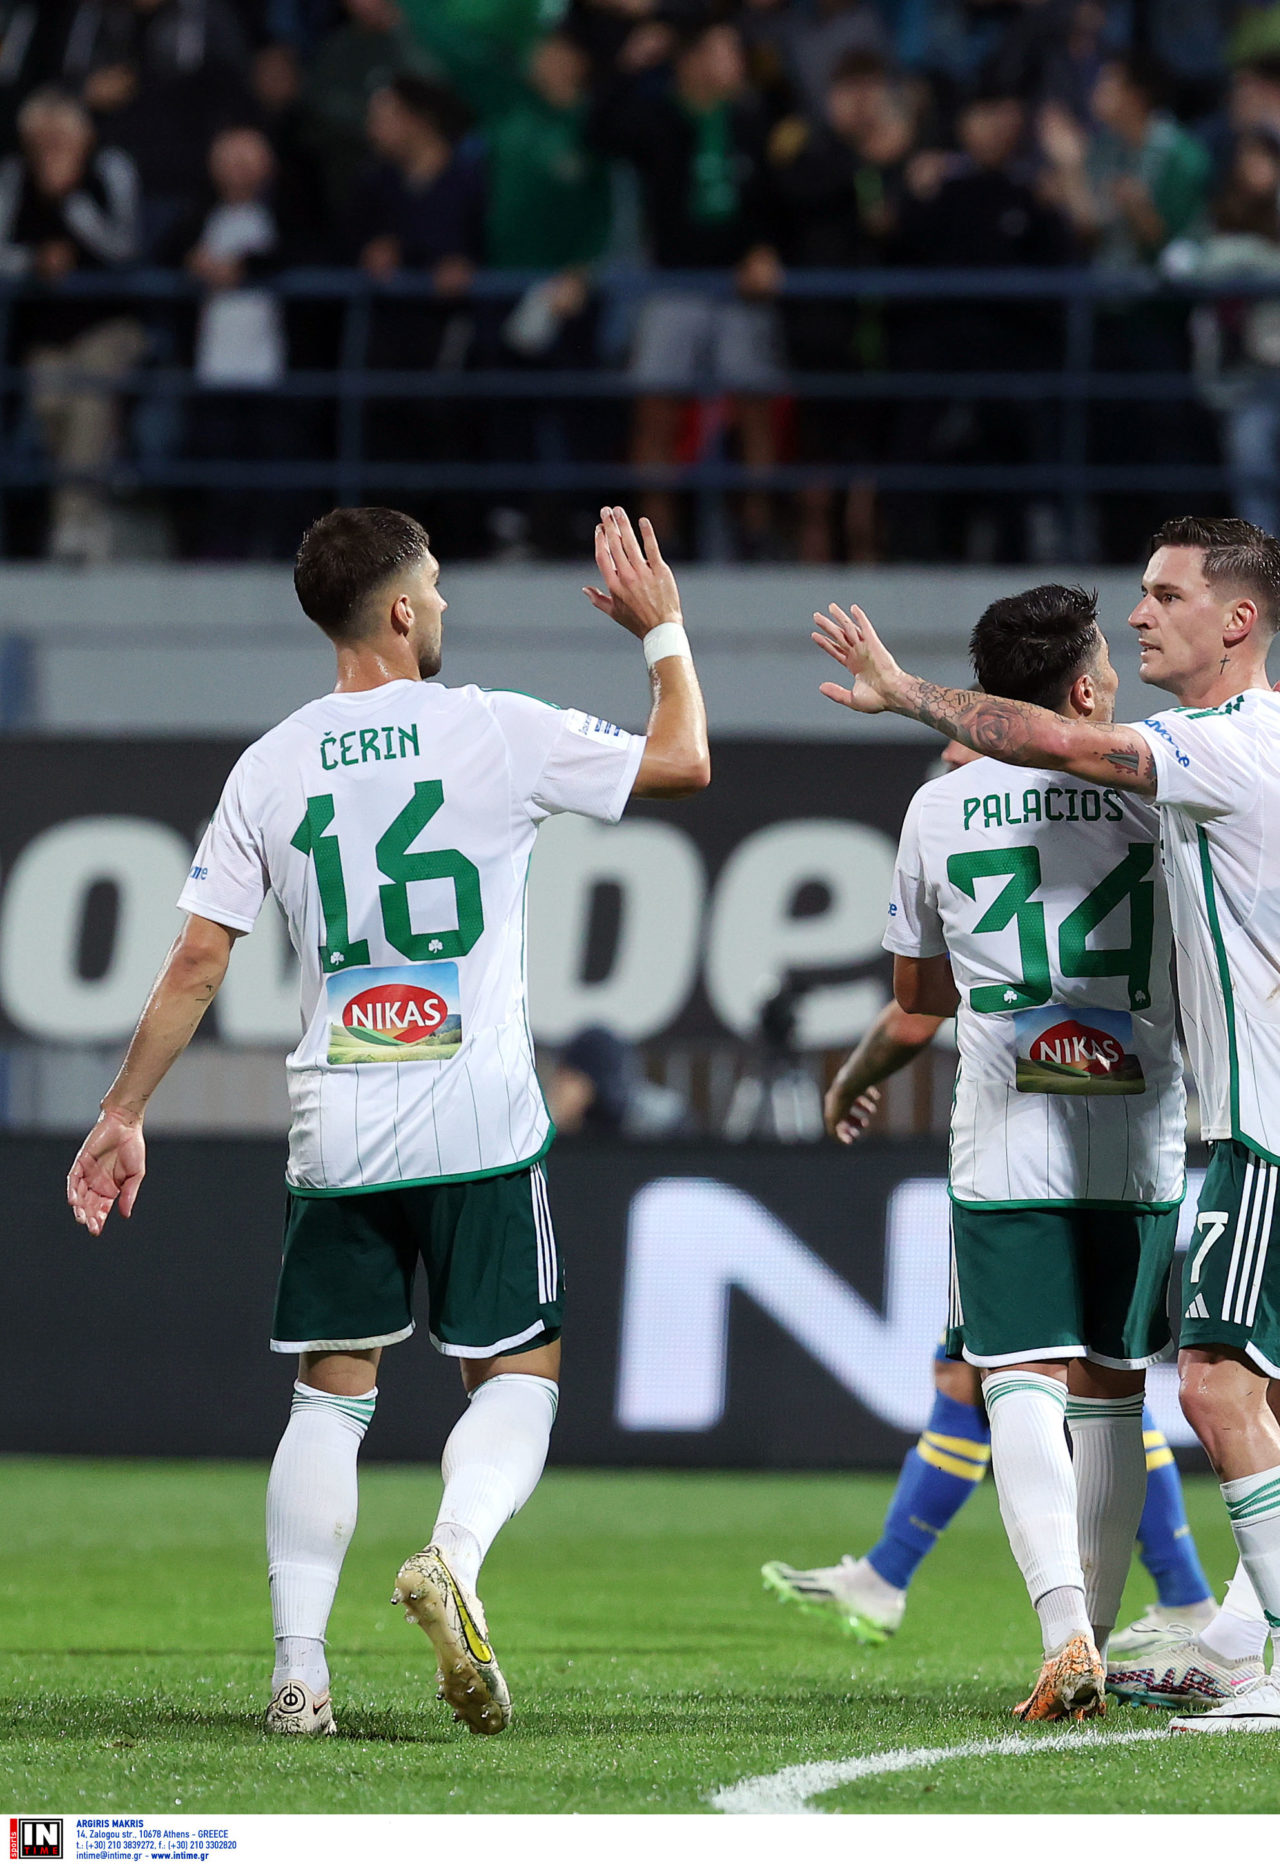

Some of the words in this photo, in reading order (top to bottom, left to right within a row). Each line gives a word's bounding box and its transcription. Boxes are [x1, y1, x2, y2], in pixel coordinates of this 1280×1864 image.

[320, 723, 420, 771] ČERIN
[963, 787, 1124, 831] PALACIOS
[290, 779, 484, 974] 16
[946, 843, 1155, 1014] 34
[350, 997, 442, 1030] NIKAS
[1039, 1035, 1120, 1064] NIKAS
[1190, 1210, 1229, 1284] 7
